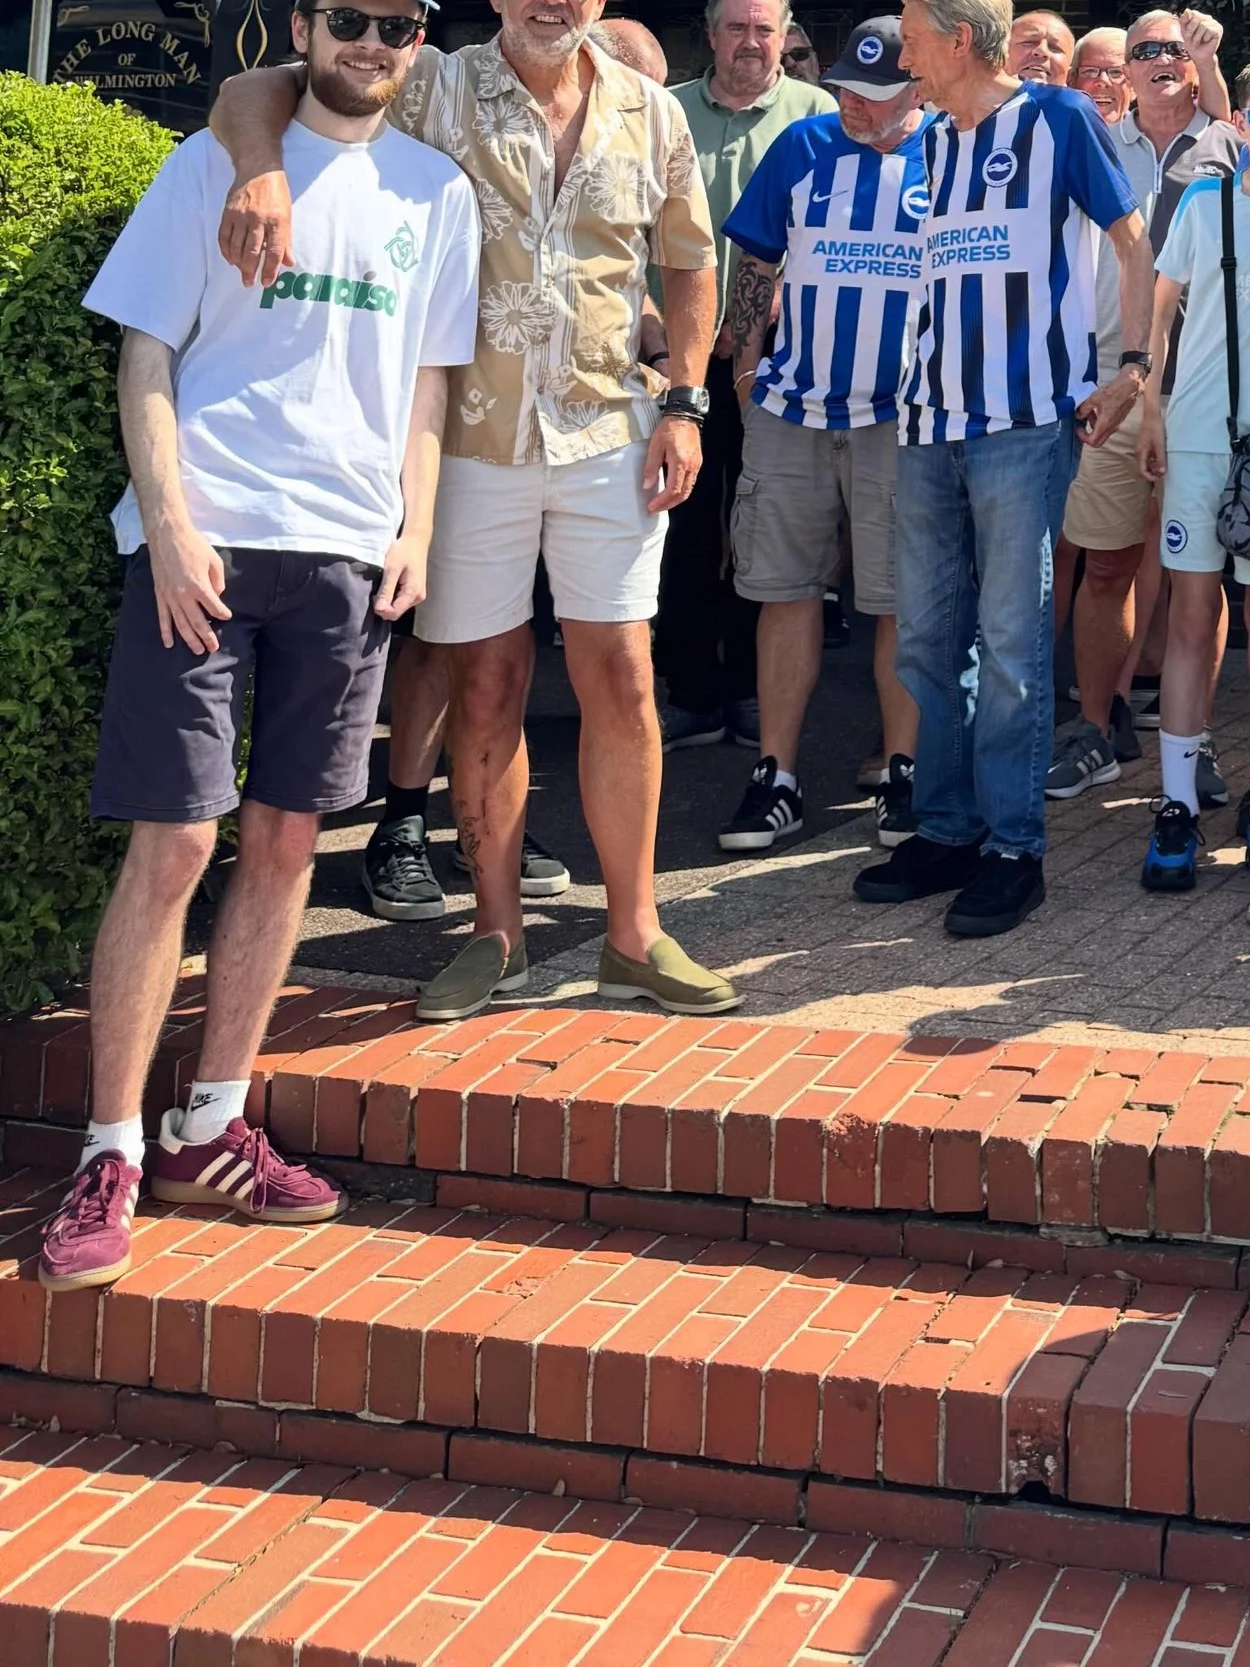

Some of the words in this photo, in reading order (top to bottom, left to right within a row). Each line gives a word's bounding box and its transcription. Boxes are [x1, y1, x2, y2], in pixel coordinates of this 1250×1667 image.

[52, 38, 92, 83] THE
[96, 20, 157, 47] LONG
[159, 31, 201, 84] MAN
[117, 53, 136, 66] OF
[74, 73, 176, 89] WILMINGTON
[927, 225, 1009, 254] AMERICAN
[812, 240, 924, 262] AMERICAN
[931, 244, 1011, 269] EXPRESS
[825, 259, 922, 279] EXPRESS
